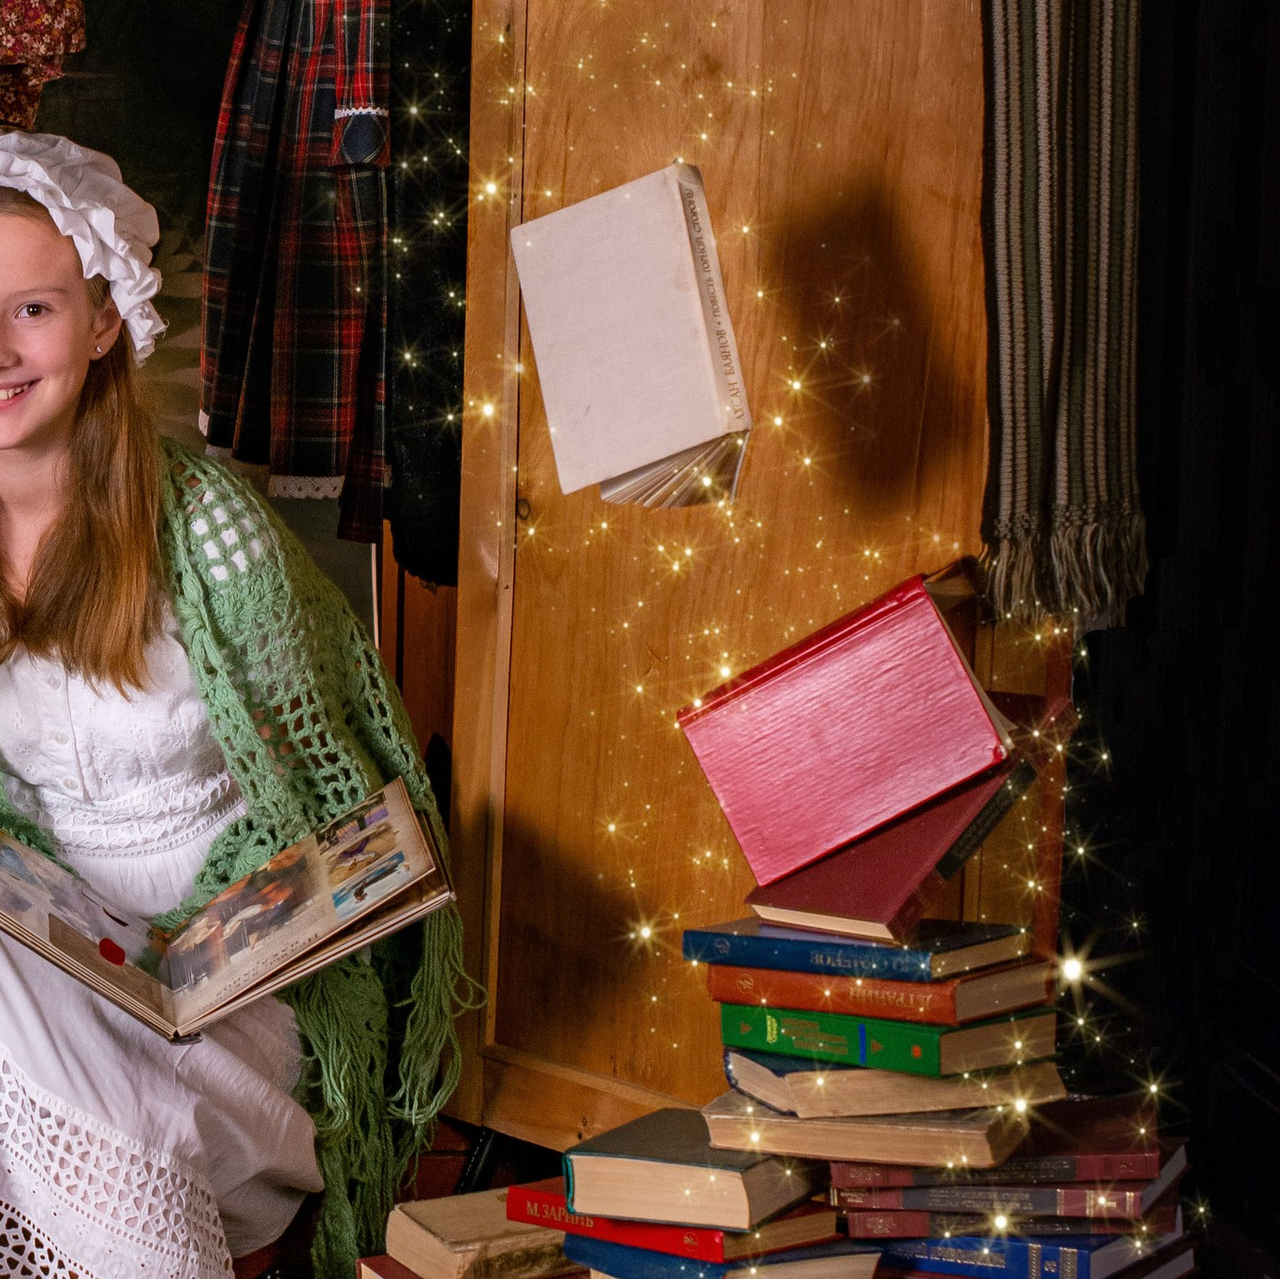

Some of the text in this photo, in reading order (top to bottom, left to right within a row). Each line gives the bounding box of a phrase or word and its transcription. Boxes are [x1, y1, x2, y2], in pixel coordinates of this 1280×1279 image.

[695, 236, 712, 274] ГОРНОЙ
[705, 275, 721, 319] ПОВЕСТЬ
[716, 329, 735, 376] БАЯНОВ
[728, 381, 745, 420] АХСАН
